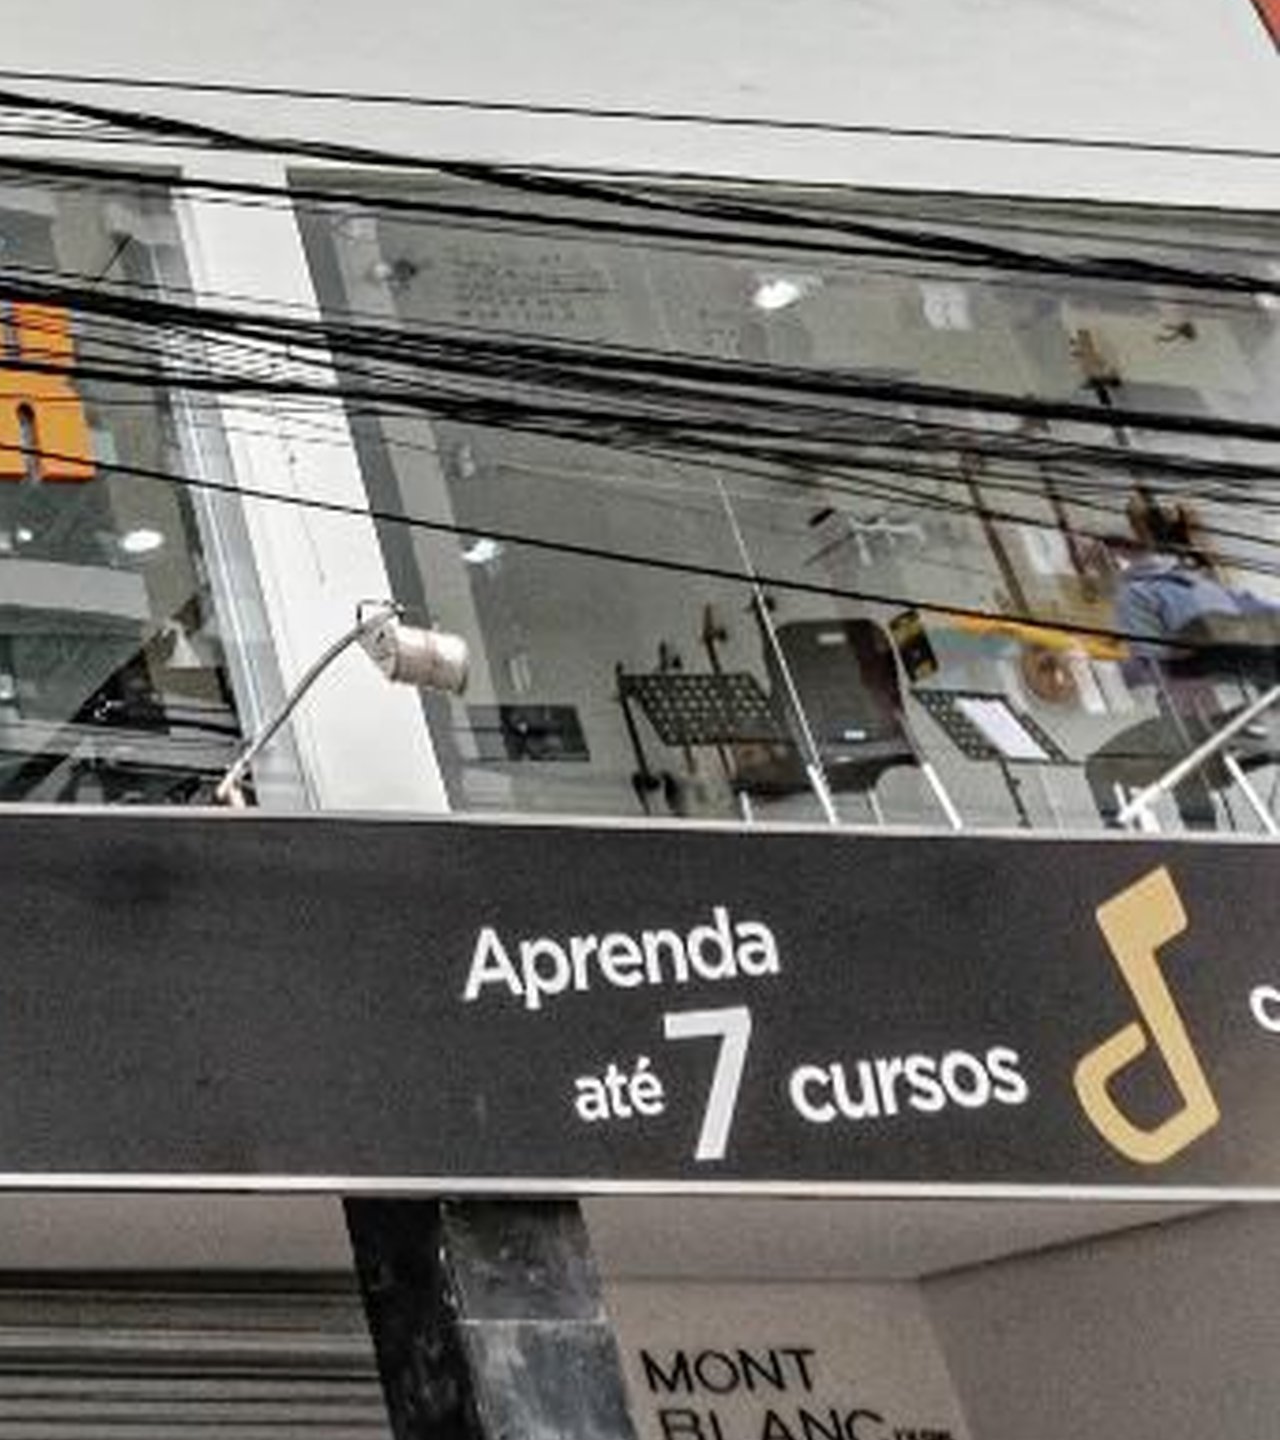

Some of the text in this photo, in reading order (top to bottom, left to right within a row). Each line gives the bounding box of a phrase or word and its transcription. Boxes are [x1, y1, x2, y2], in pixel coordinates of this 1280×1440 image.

[463, 906, 780, 1010] Aprenda
[573, 1006, 1028, 1161] até 7 cursos
[639, 1346, 816, 1396] MONT
